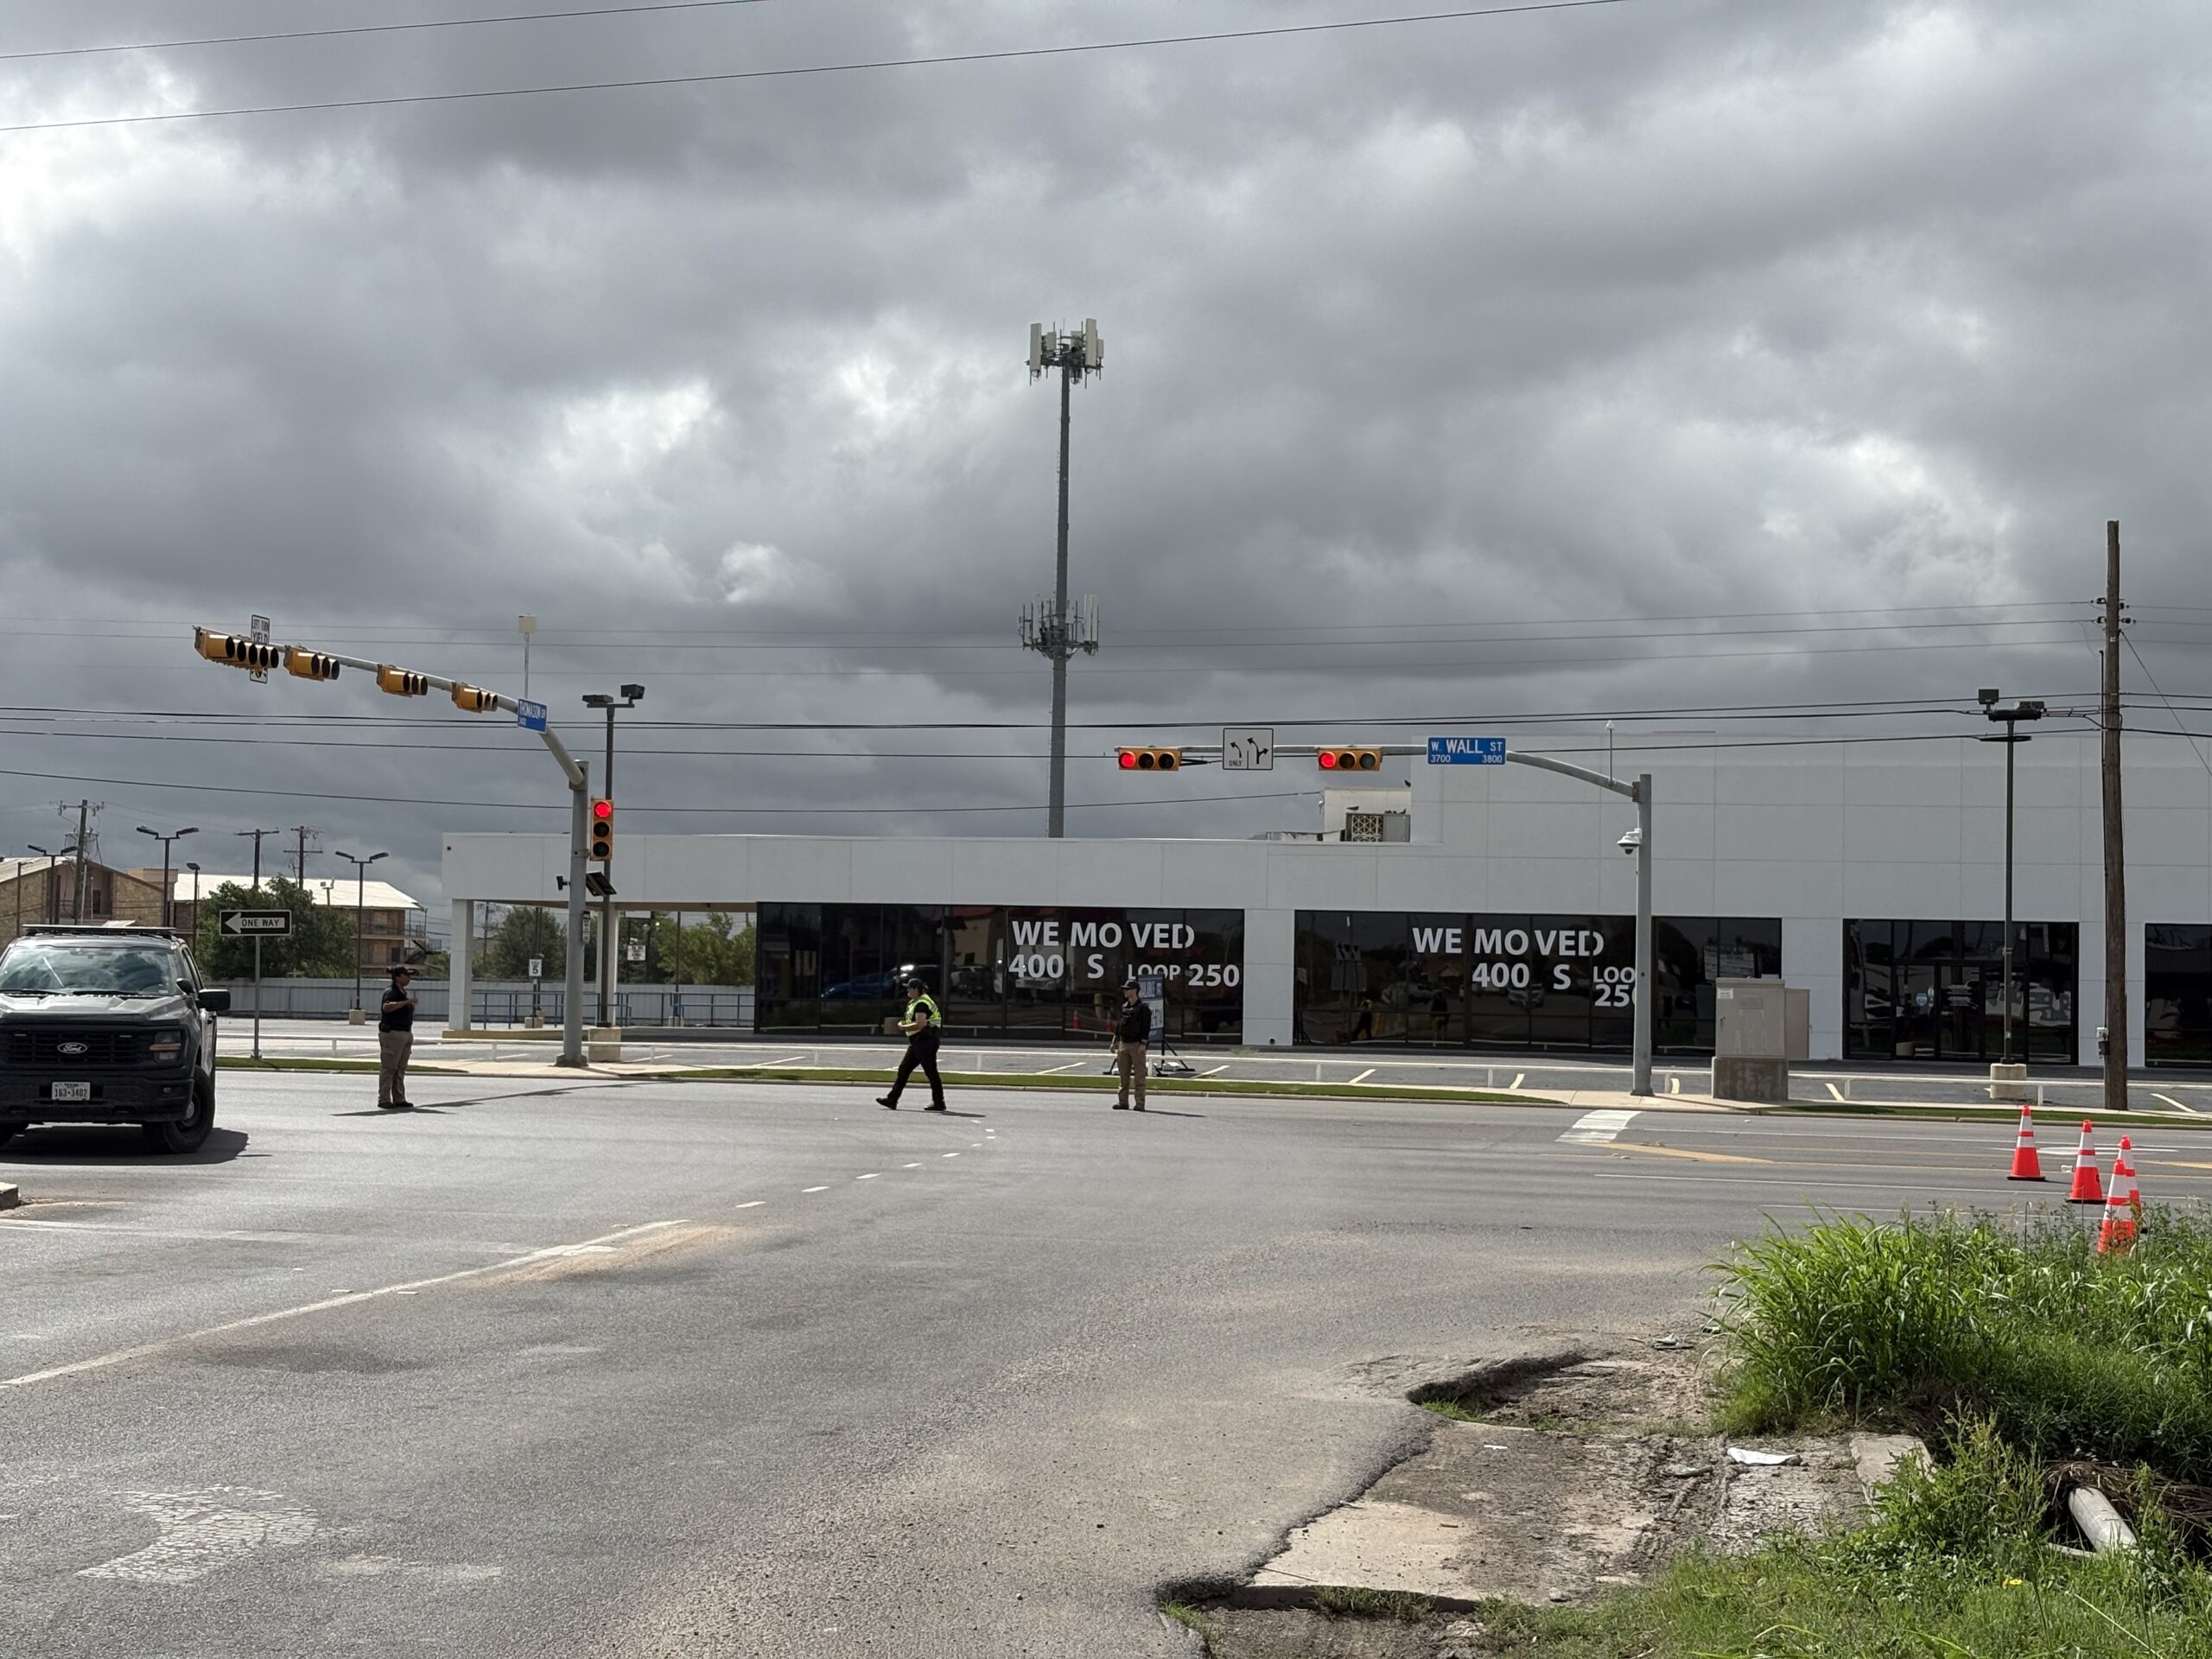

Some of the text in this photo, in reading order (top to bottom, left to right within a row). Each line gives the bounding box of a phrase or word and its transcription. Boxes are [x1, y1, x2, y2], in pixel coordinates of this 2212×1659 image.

[252, 631, 268, 645] YIELD
[519, 701, 541, 719] THOMASON
[1446, 740, 1484, 753] WALL
[1490, 742, 1503, 752] ST
[1431, 754, 1503, 763] 3700 3800
[242, 918, 280, 927] ONE WAY
[1012, 921, 1059, 946] WE
[1412, 928, 1462, 954] WE
[532, 966, 538, 975] 5
[1008, 954, 1240, 988] 400 S LOOP 250
[1472, 963, 1636, 989] 400 S LOO
[1594, 983, 1636, 1007] 25
